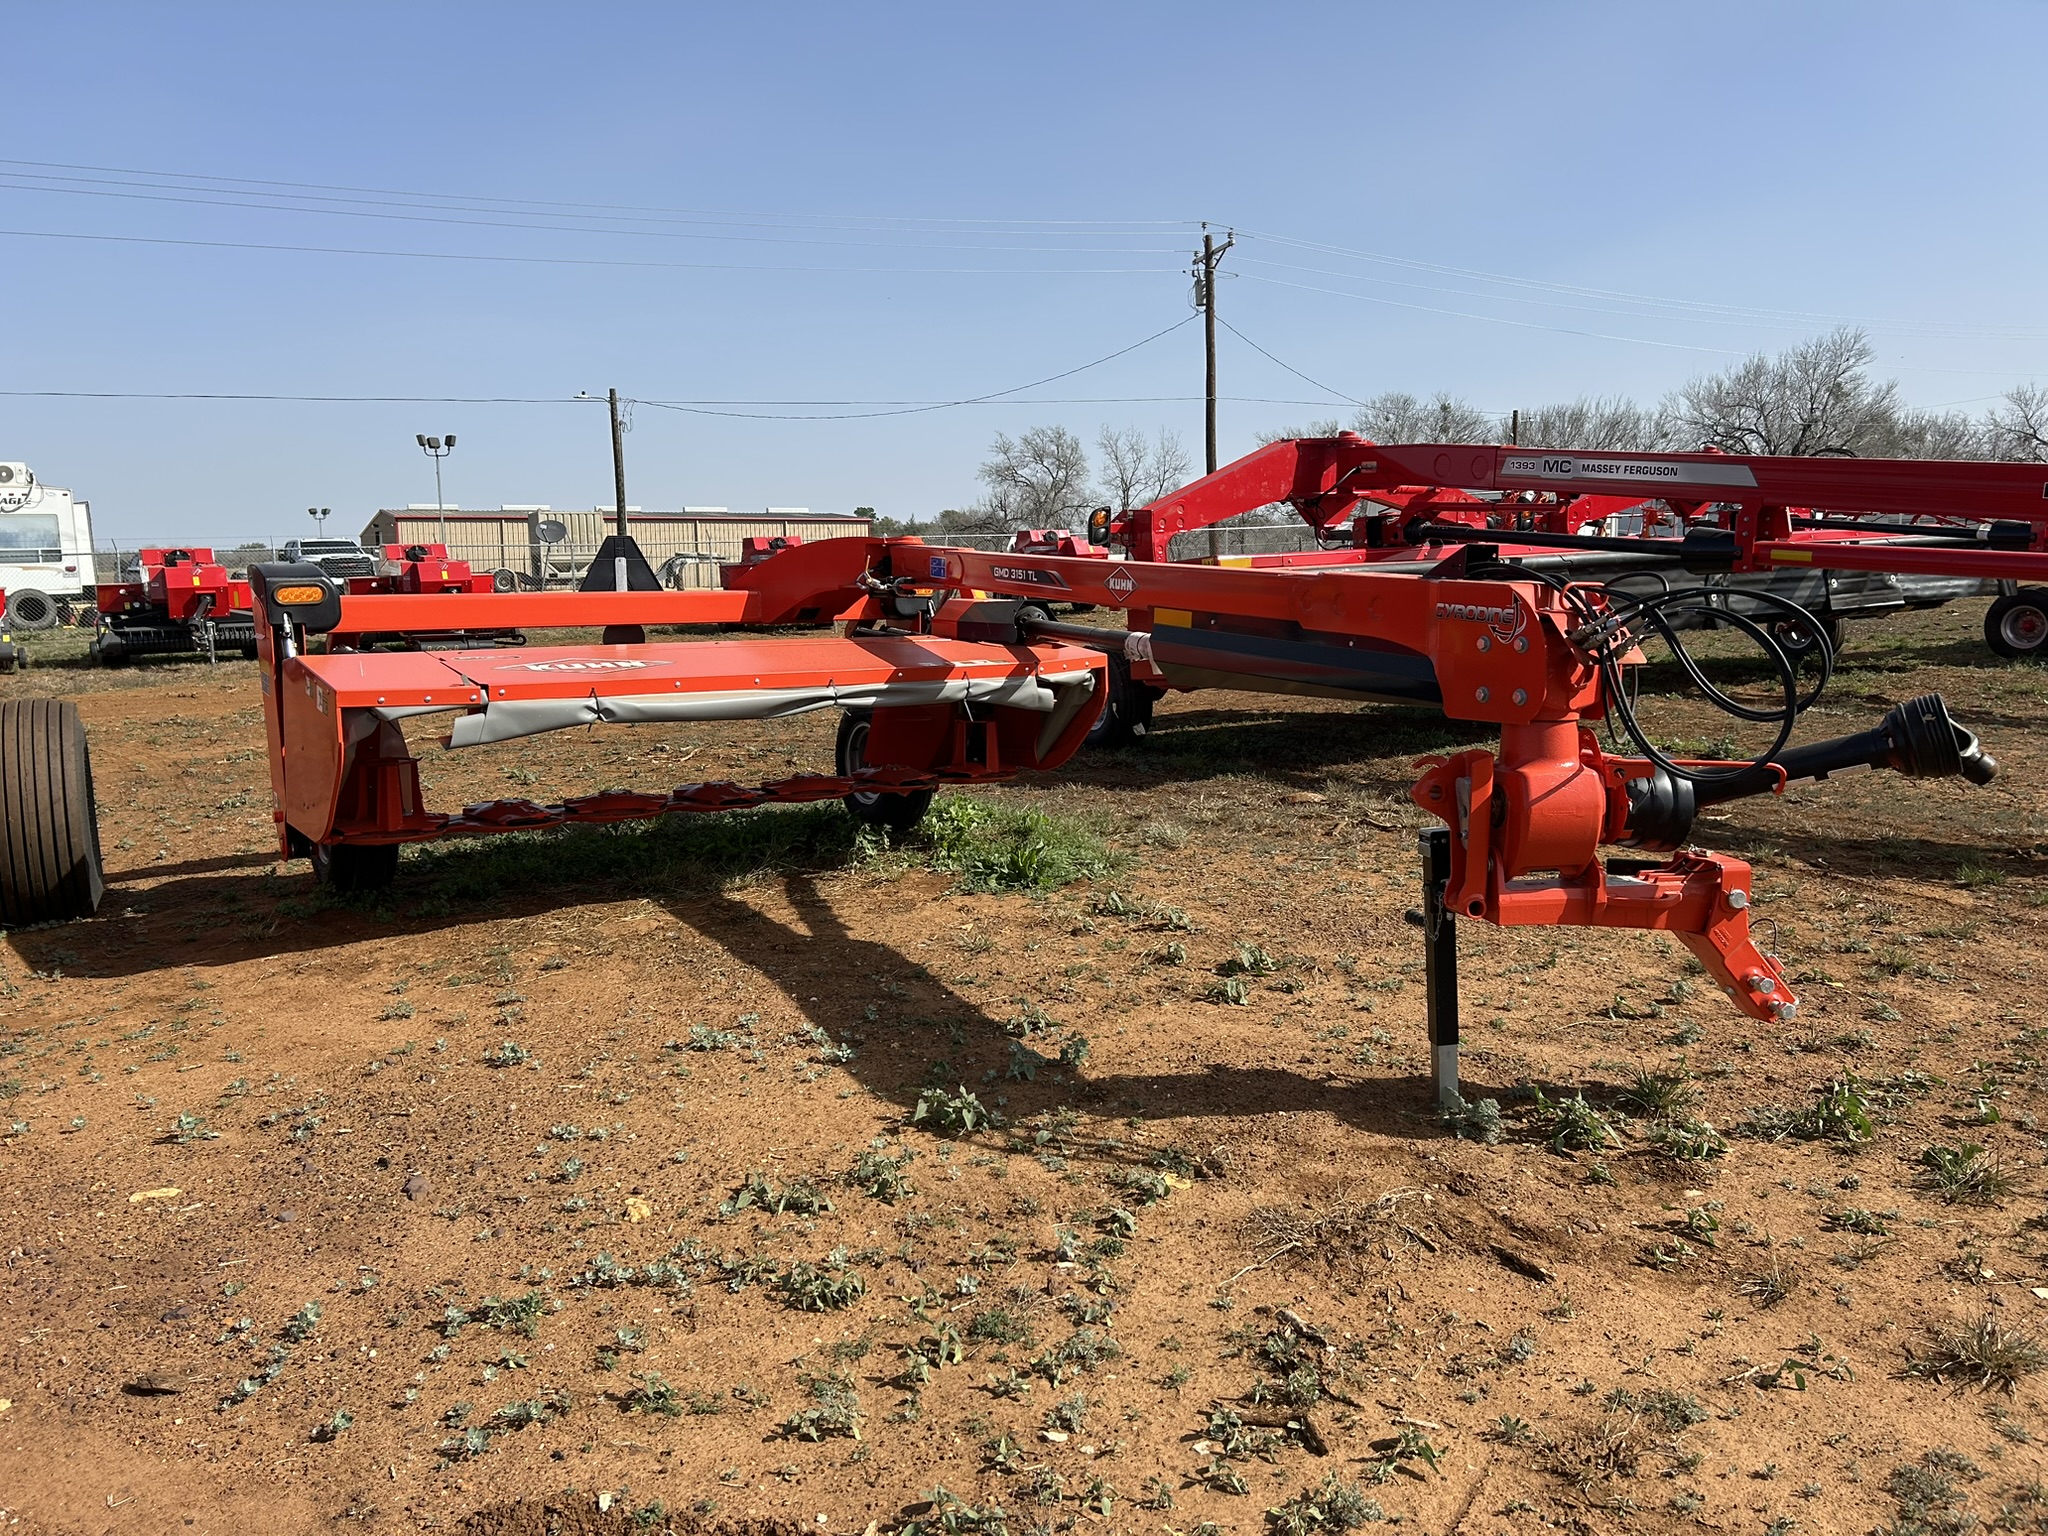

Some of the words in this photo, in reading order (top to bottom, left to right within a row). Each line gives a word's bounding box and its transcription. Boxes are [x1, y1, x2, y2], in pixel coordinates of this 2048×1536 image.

[1509, 461, 1536, 470] 1393
[1542, 459, 1572, 474] MC
[1581, 463, 1621, 474] MASSEY
[1623, 465, 1678, 477] FERGUSON
[993, 567, 1010, 578] GMD
[1010, 568, 1026, 580] 3151
[1027, 570, 1038, 581] TL
[1109, 577, 1133, 592] KUHN
[1436, 602, 1515, 625] GYRODINE
[526, 660, 647, 672] KUHN
